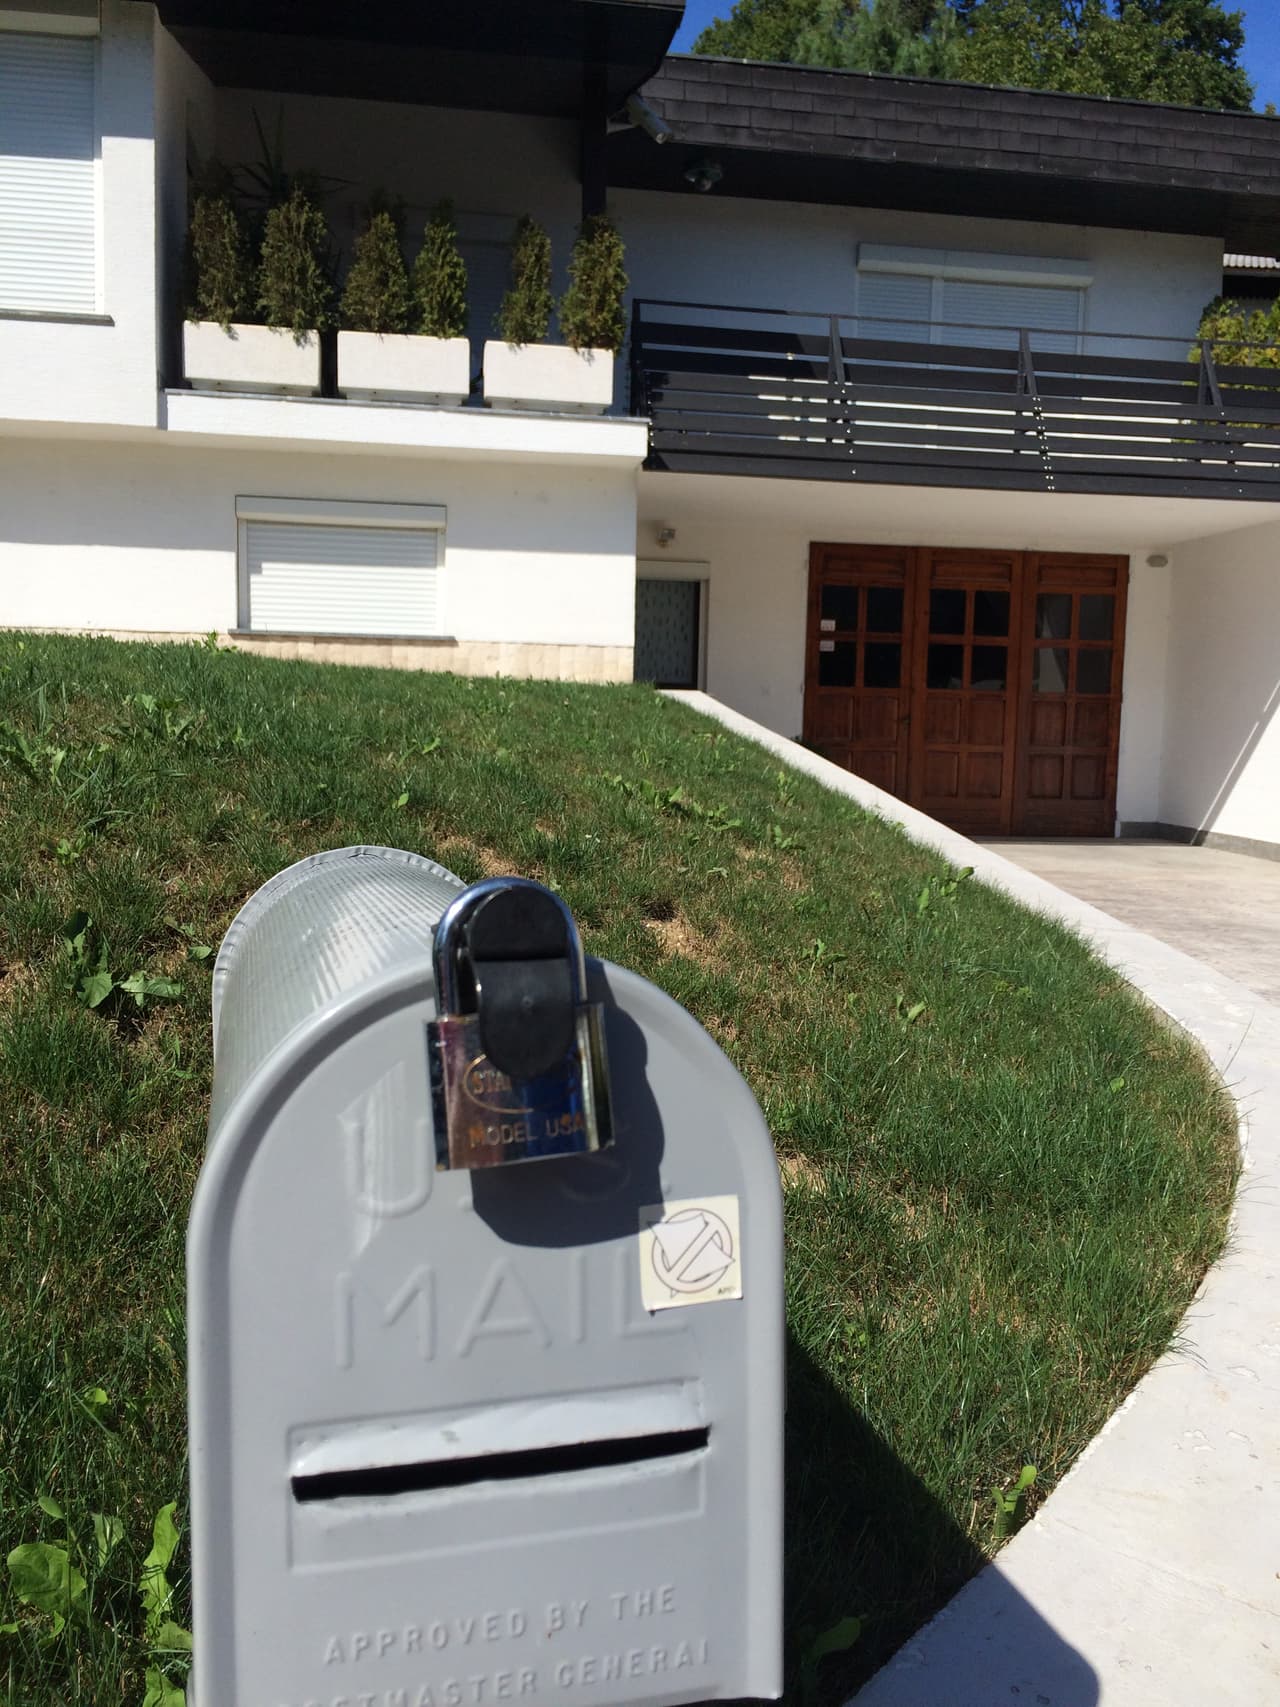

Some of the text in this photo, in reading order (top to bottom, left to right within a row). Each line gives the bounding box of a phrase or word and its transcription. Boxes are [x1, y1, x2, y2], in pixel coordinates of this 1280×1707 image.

[468, 1111, 588, 1149] MODEL USA
[334, 1245, 689, 1373] MAIL
[323, 1583, 677, 1667] APPROVED BY THE
